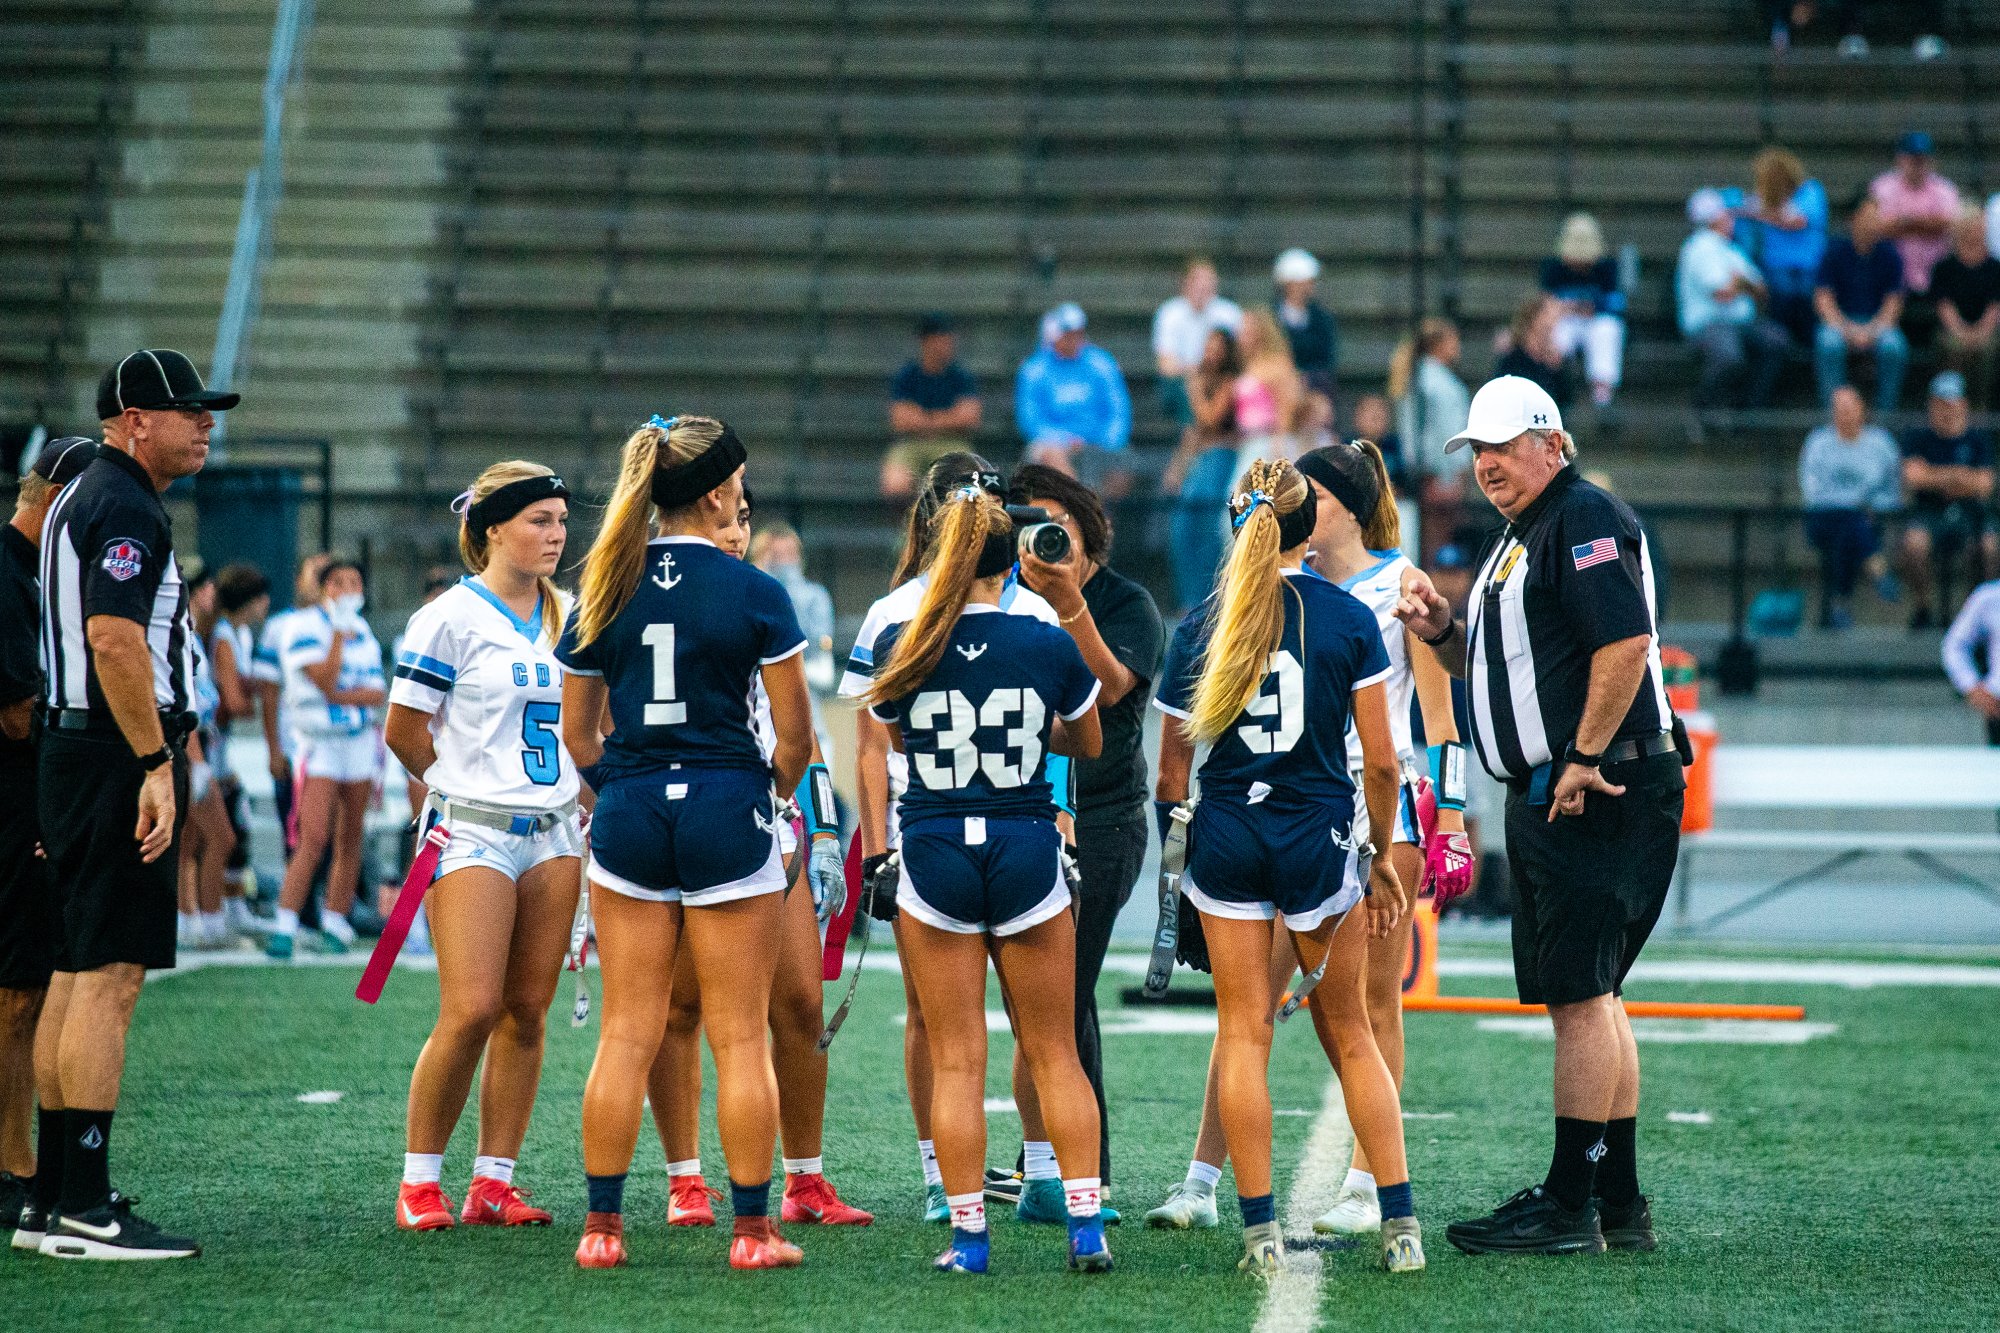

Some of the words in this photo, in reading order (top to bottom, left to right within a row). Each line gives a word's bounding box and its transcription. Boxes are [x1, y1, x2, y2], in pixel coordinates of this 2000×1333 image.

[110, 560, 136, 570] CFOA
[512, 662, 563, 687] CD
[642, 623, 688, 726] 1
[1238, 649, 1305, 754] 9
[521, 701, 561, 786] 5
[909, 688, 1046, 790] 33
